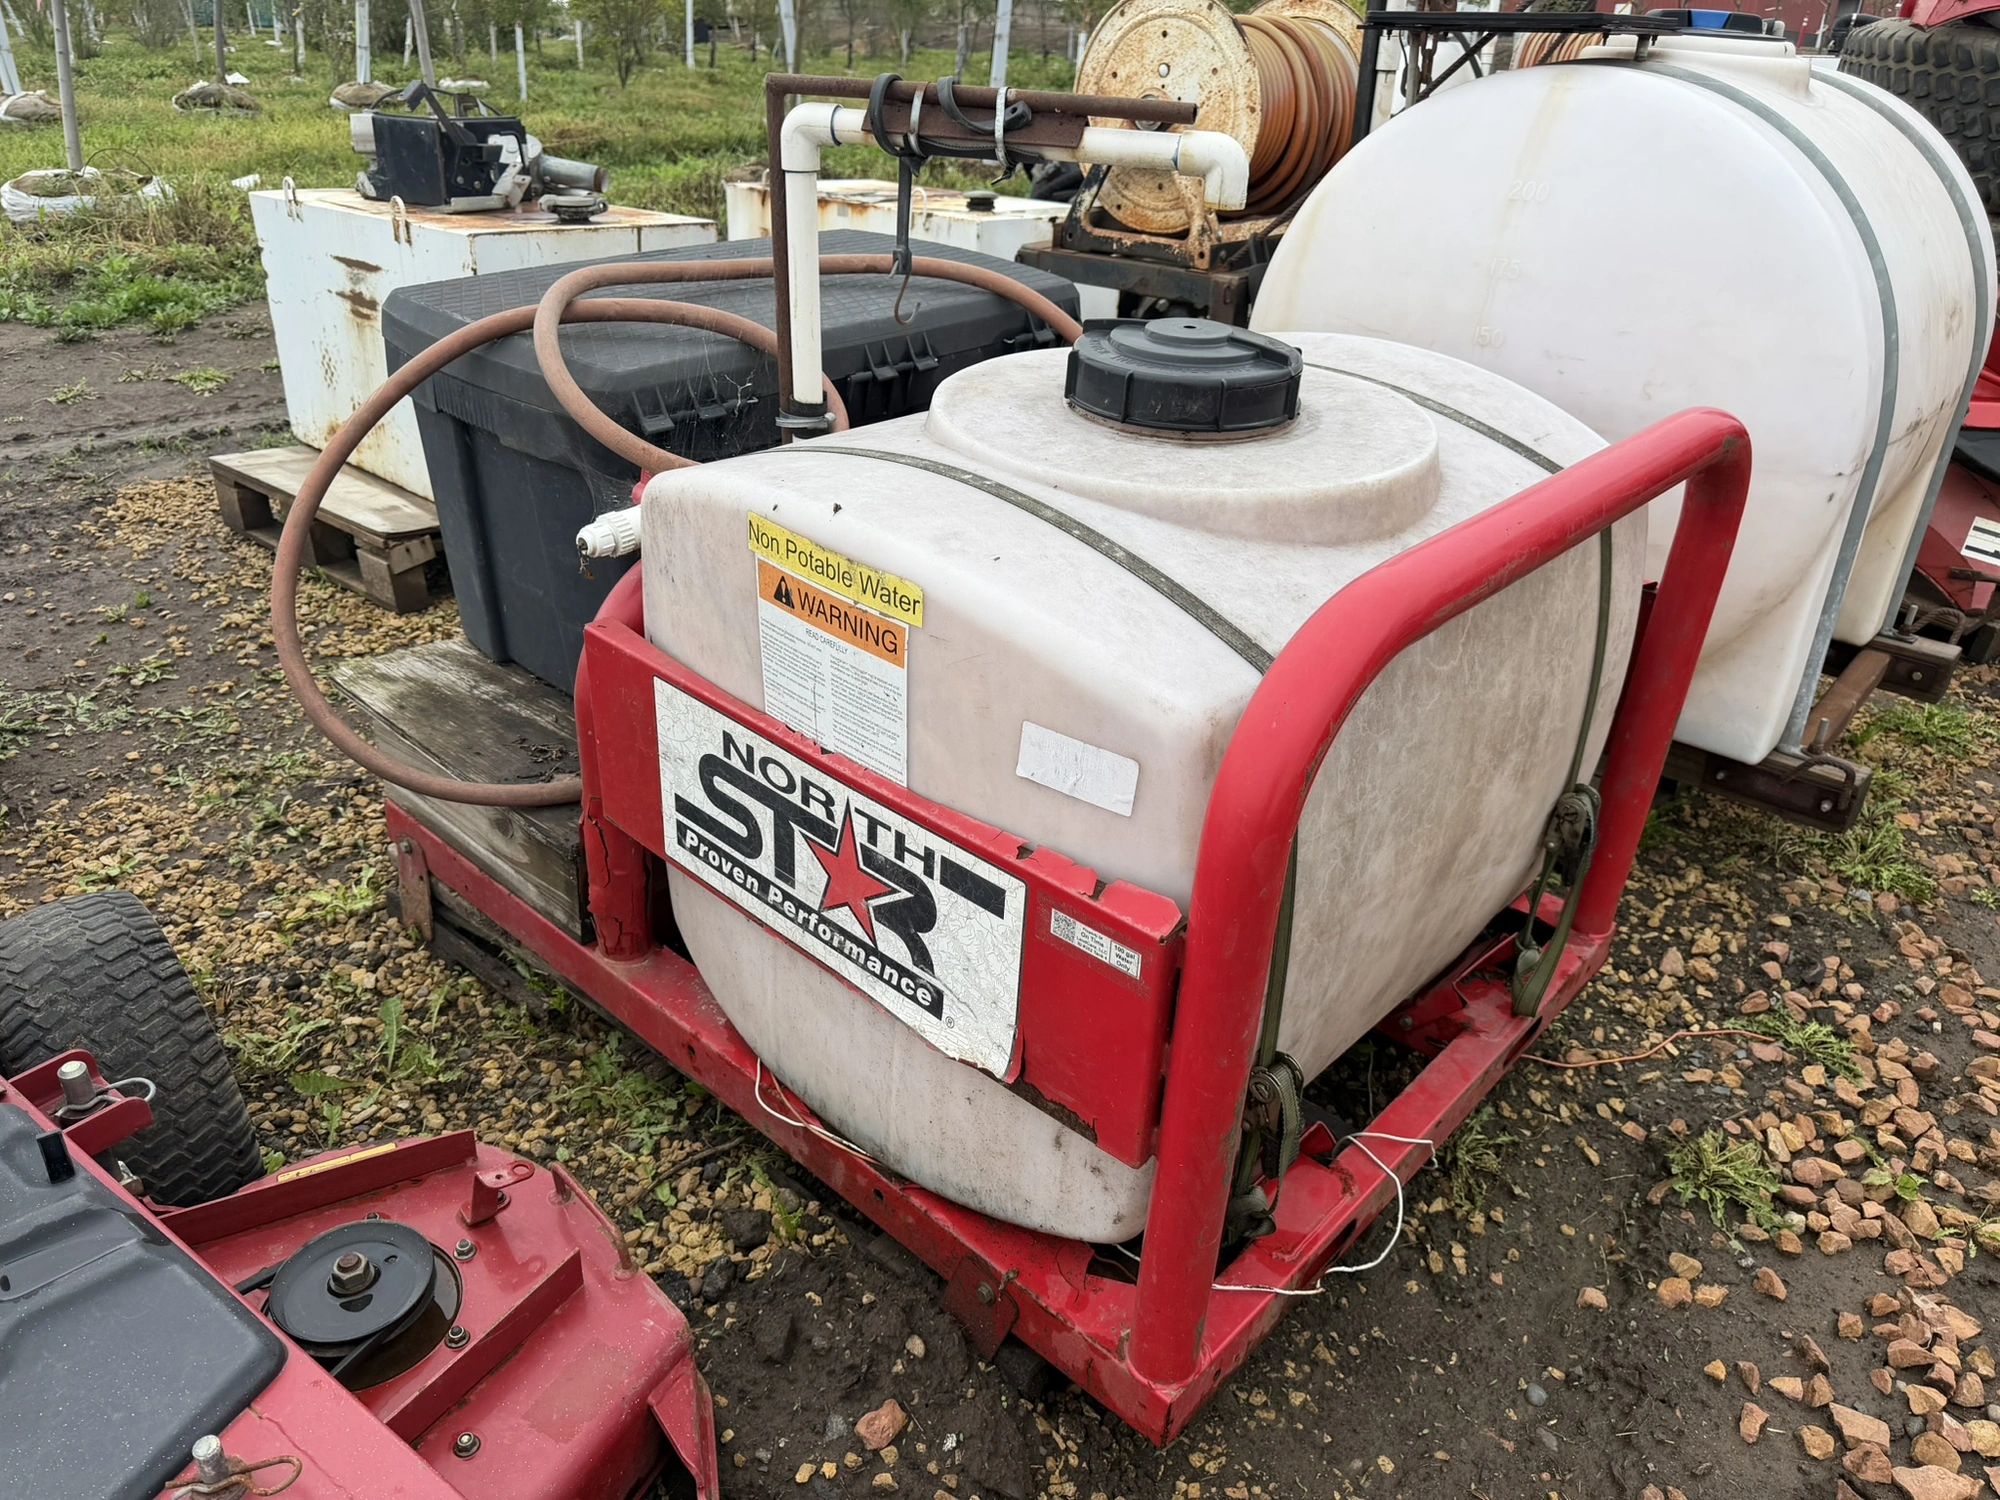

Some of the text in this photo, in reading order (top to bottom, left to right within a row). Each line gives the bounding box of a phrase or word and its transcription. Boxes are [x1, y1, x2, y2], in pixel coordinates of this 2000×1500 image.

[1508, 180, 1550, 202] 200
[1490, 257, 1521, 280] 175
[1473, 325, 1506, 348] 150
[748, 519, 921, 615] Non Potable Water
[797, 587, 898, 656] WARNING
[805, 627, 820, 642] READ
[722, 729, 936, 881] NORTH
[684, 829, 933, 1008] Proven Performance
[1114, 944, 1125, 955] 100
[1115, 952, 1133, 965] Water
[1116, 960, 1130, 972] Only
